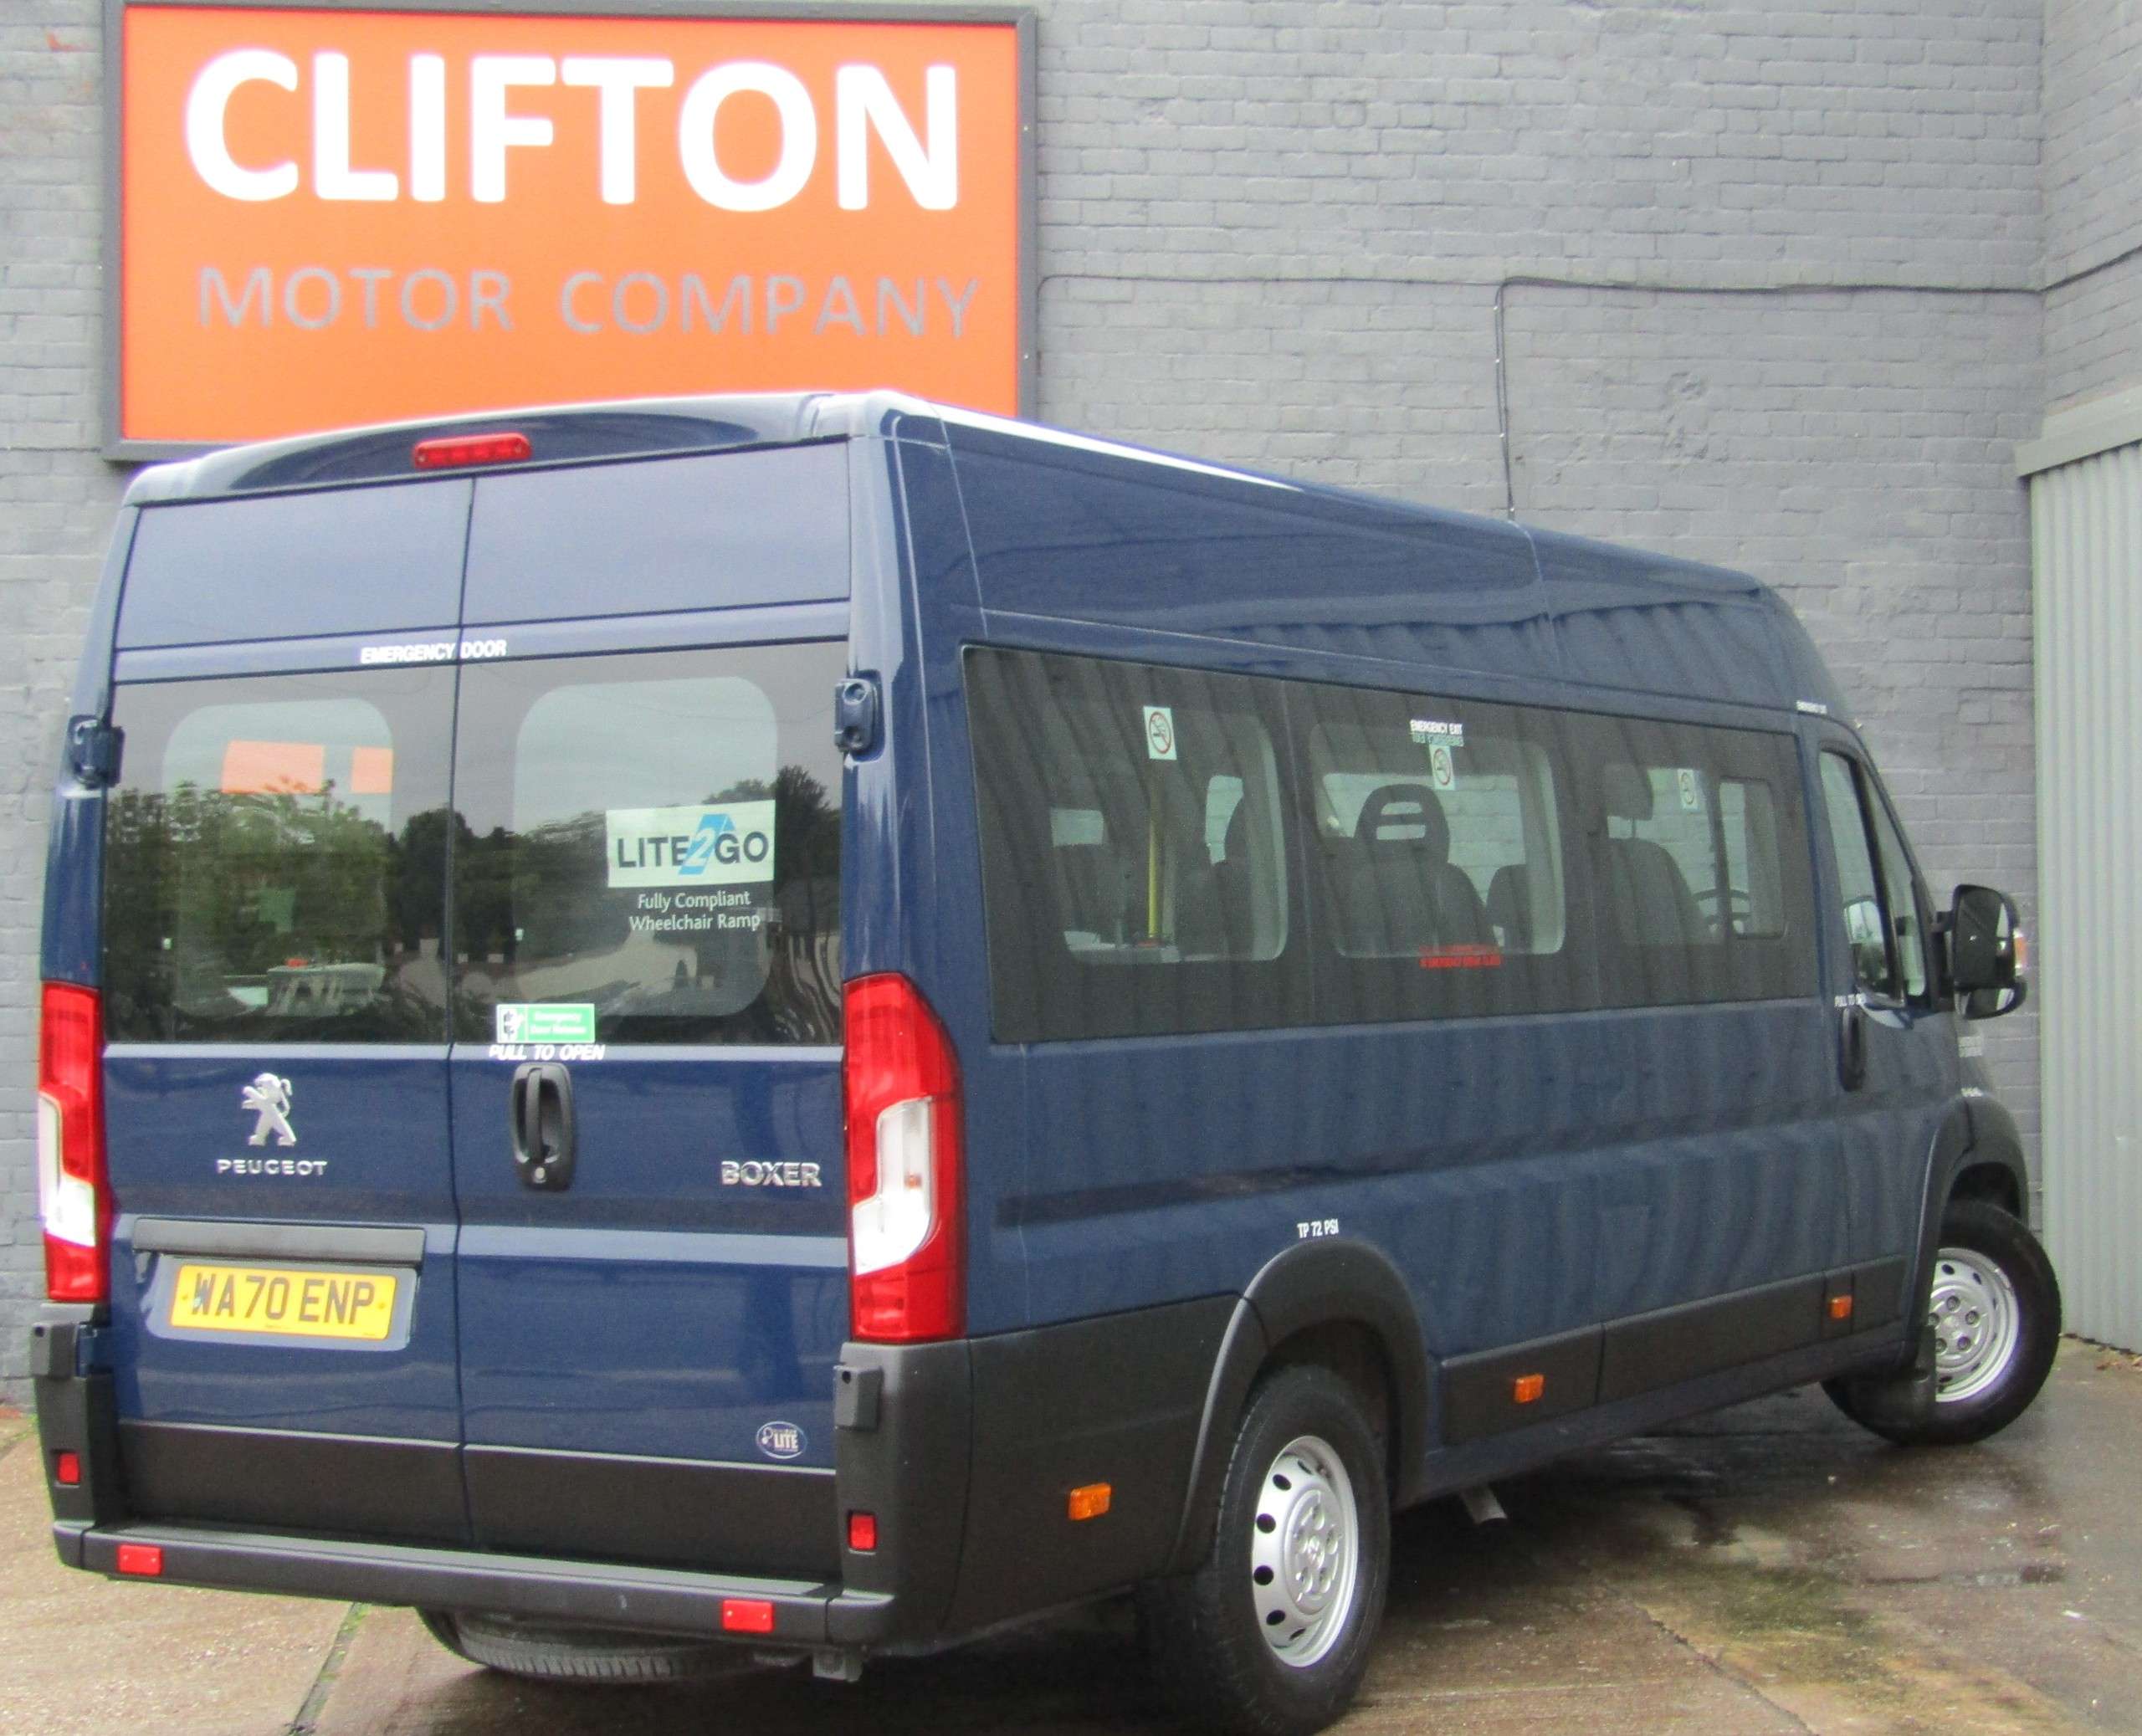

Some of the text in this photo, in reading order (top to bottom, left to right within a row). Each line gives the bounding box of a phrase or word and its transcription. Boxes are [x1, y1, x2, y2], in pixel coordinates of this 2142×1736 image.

[186, 49, 958, 213] CLIFTON
[197, 266, 980, 339] MOTOR COMPANY
[360, 639, 508, 664] EMERGENCY DOOR
[638, 890, 752, 913] Fully Compliant
[629, 914, 761, 931] Wheelchair Ramp
[489, 1044, 606, 1060] PULL TO OPEN
[216, 1159, 329, 1176] PEUGEOT
[721, 1160, 822, 1188] BOXER
[1297, 1218, 1340, 1238] TP 72 PSI
[192, 1271, 376, 1326] WA70 ENP
[774, 1431, 798, 1450] LITE
